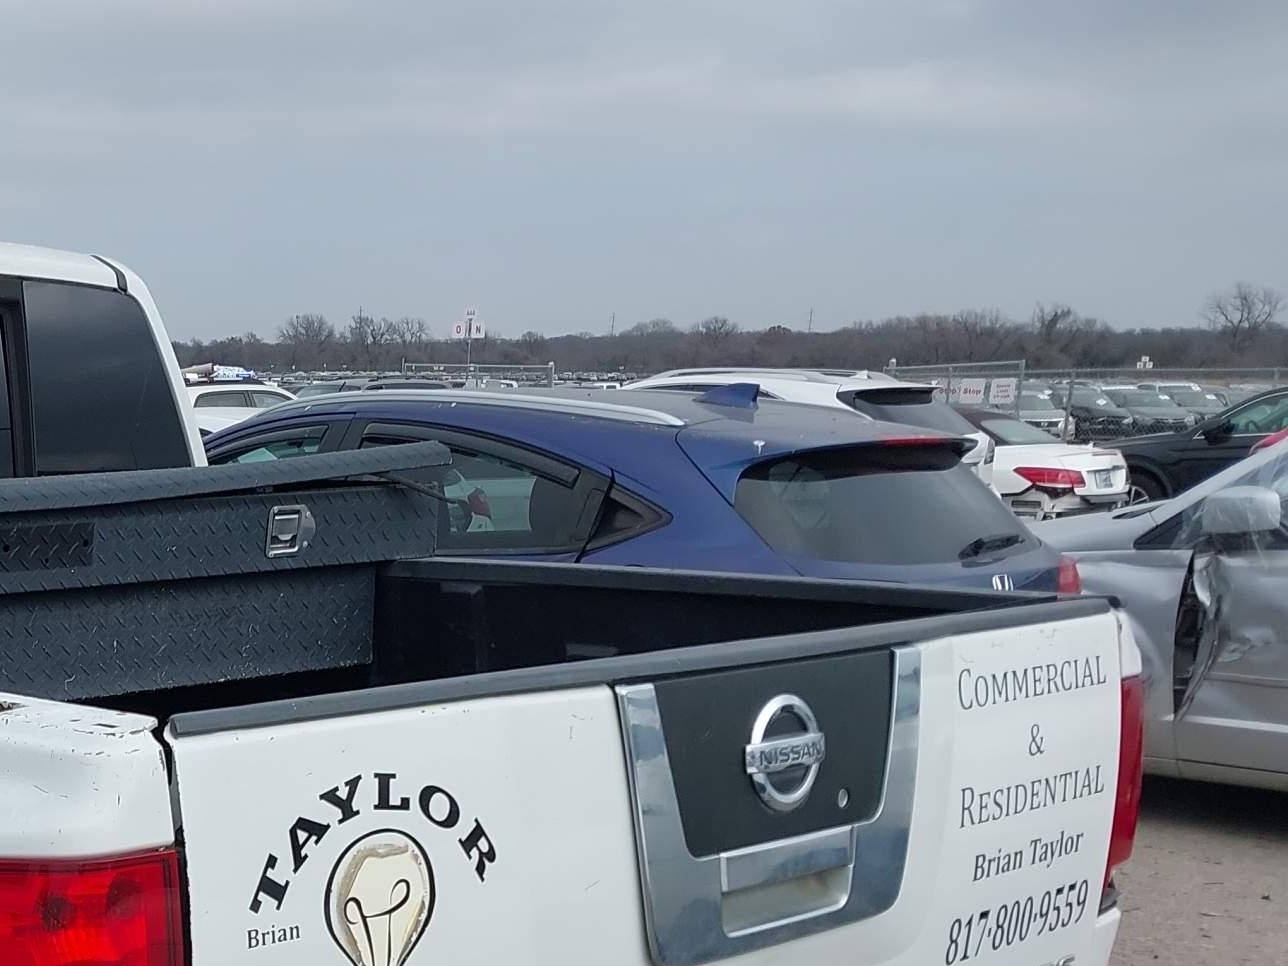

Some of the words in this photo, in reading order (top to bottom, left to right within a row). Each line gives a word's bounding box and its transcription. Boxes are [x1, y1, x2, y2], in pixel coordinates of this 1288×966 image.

[759, 742, 822, 766] NISSAN
[1028, 724, 1044, 756] &
[249, 773, 497, 915] TAYLOR
[973, 849, 1023, 882] Brian
[1029, 830, 1084, 870] Taylor
[247, 924, 301, 950] Brian
